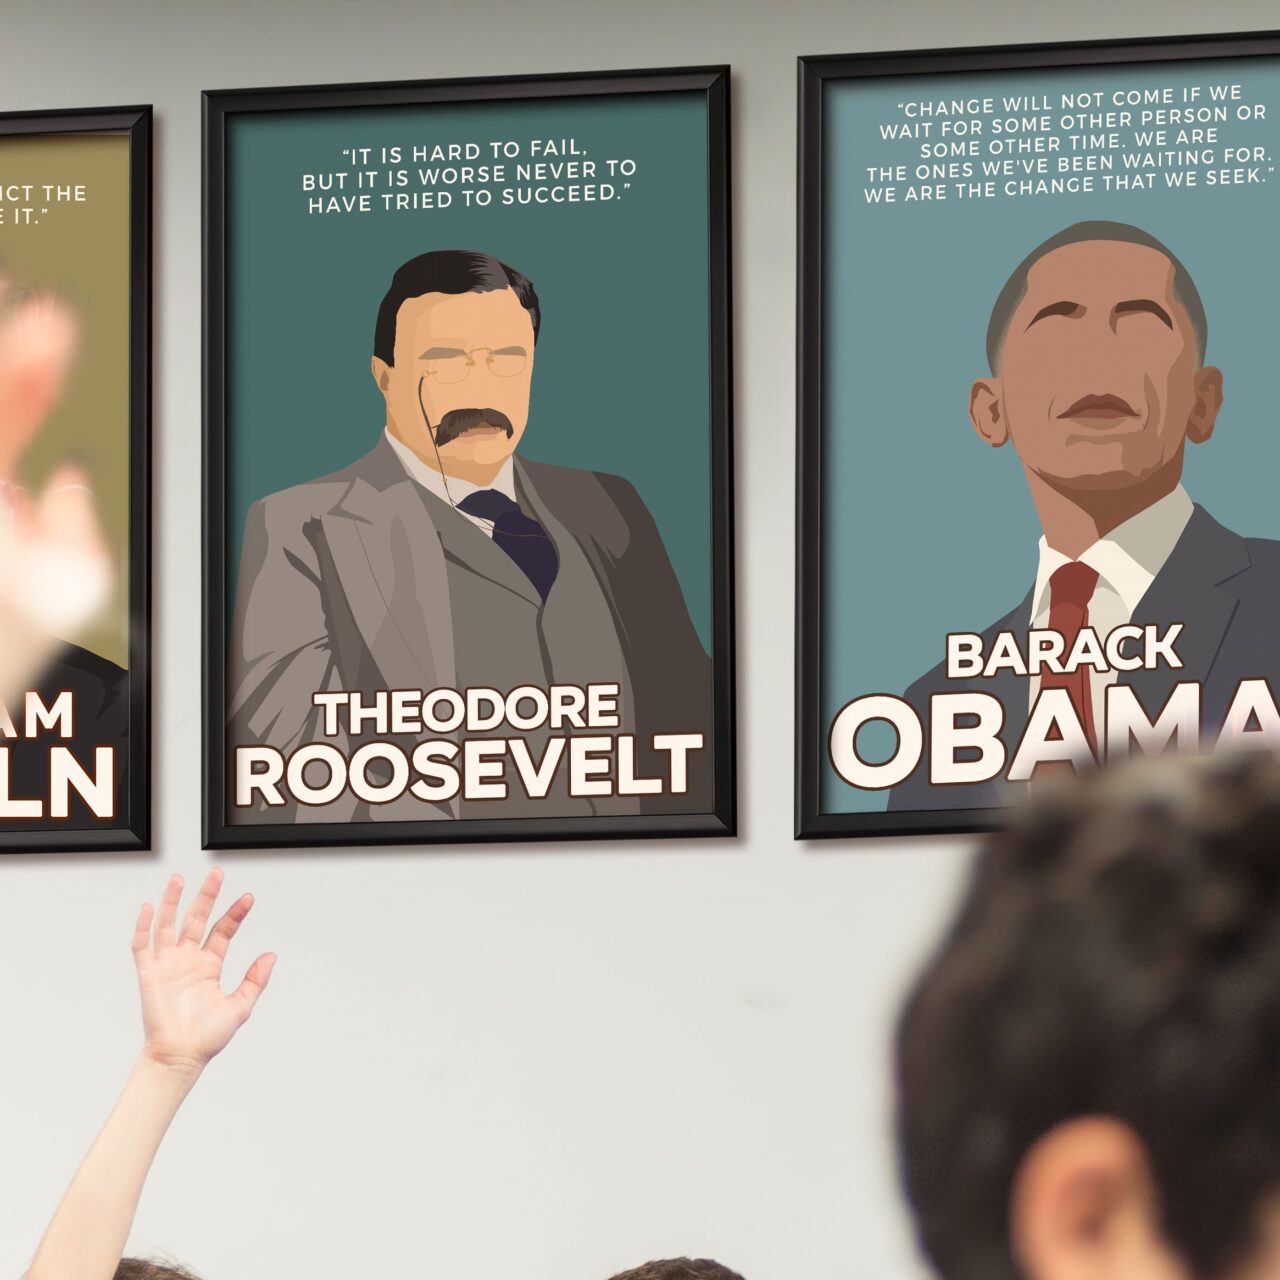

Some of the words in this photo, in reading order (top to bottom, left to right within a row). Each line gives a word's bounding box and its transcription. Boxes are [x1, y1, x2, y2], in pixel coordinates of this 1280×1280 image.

[897, 98, 994, 118] “CHANGE
[1002, 95, 1052, 112] WILL
[1061, 92, 1104, 109] NOT
[1112, 88, 1173, 106] COME
[1183, 87, 1201, 102] IF
[1209, 85, 1241, 101] WE
[879, 122, 933, 140] WAIT
[942, 120, 982, 137] FOR
[991, 116, 1051, 134] SOME
[1060, 111, 1132, 130] OTHER
[1142, 106, 1227, 126] PERSON
[1237, 104, 1266, 121] OR
[342, 148, 372, 166] “IT
[382, 146, 402, 164] IS
[413, 143, 480, 162] HARD
[489, 141, 520, 159] TO
[531, 138, 587, 157] FAIL,
[920, 140, 980, 159] SOME
[989, 136, 1060, 155] OTHER
[1069, 133, 1126, 150] TIME.
[1134, 130, 1167, 147] WE
[1175, 128, 1217, 145] ARE
[303, 172, 348, 191] BUT
[358, 171, 378, 189] IT
[388, 169, 408, 187] IS
[418, 165, 505, 186] WORSE
[516, 161, 596, 181] NEVER
[606, 159, 636, 177] TO
[866, 166, 906, 182] THE
[915, 162, 973, 180] ONES
[982, 158, 1048, 176] WE'VE
[1058, 155, 1113, 172] BEEN
[1122, 149, 1214, 169] WAITING
[1224, 146, 1272, 163] FOR.
[42, 185, 86, 202] THE
[309, 195, 371, 214] HAVE
[381, 191, 452, 211] TRIED
[461, 189, 492, 207] TO
[502, 183, 631, 205] SUCCEED.”
[864, 187, 896, 203] WE
[904, 184, 946, 201] ARE
[955, 182, 995, 199] THE
[1004, 176, 1094, 196] CHANGE
[1102, 173, 1156, 191] THAT
[1164, 171, 1197, 187] WE
[1206, 167, 1274, 185] SEEK.”
[15, 208, 48, 224] IT.”
[946, 624, 1185, 679] BARACK
[312, 683, 620, 736] THEODORE
[829, 678, 1280, 790] OBAMA
[234, 732, 705, 807] ROOSEVELT
